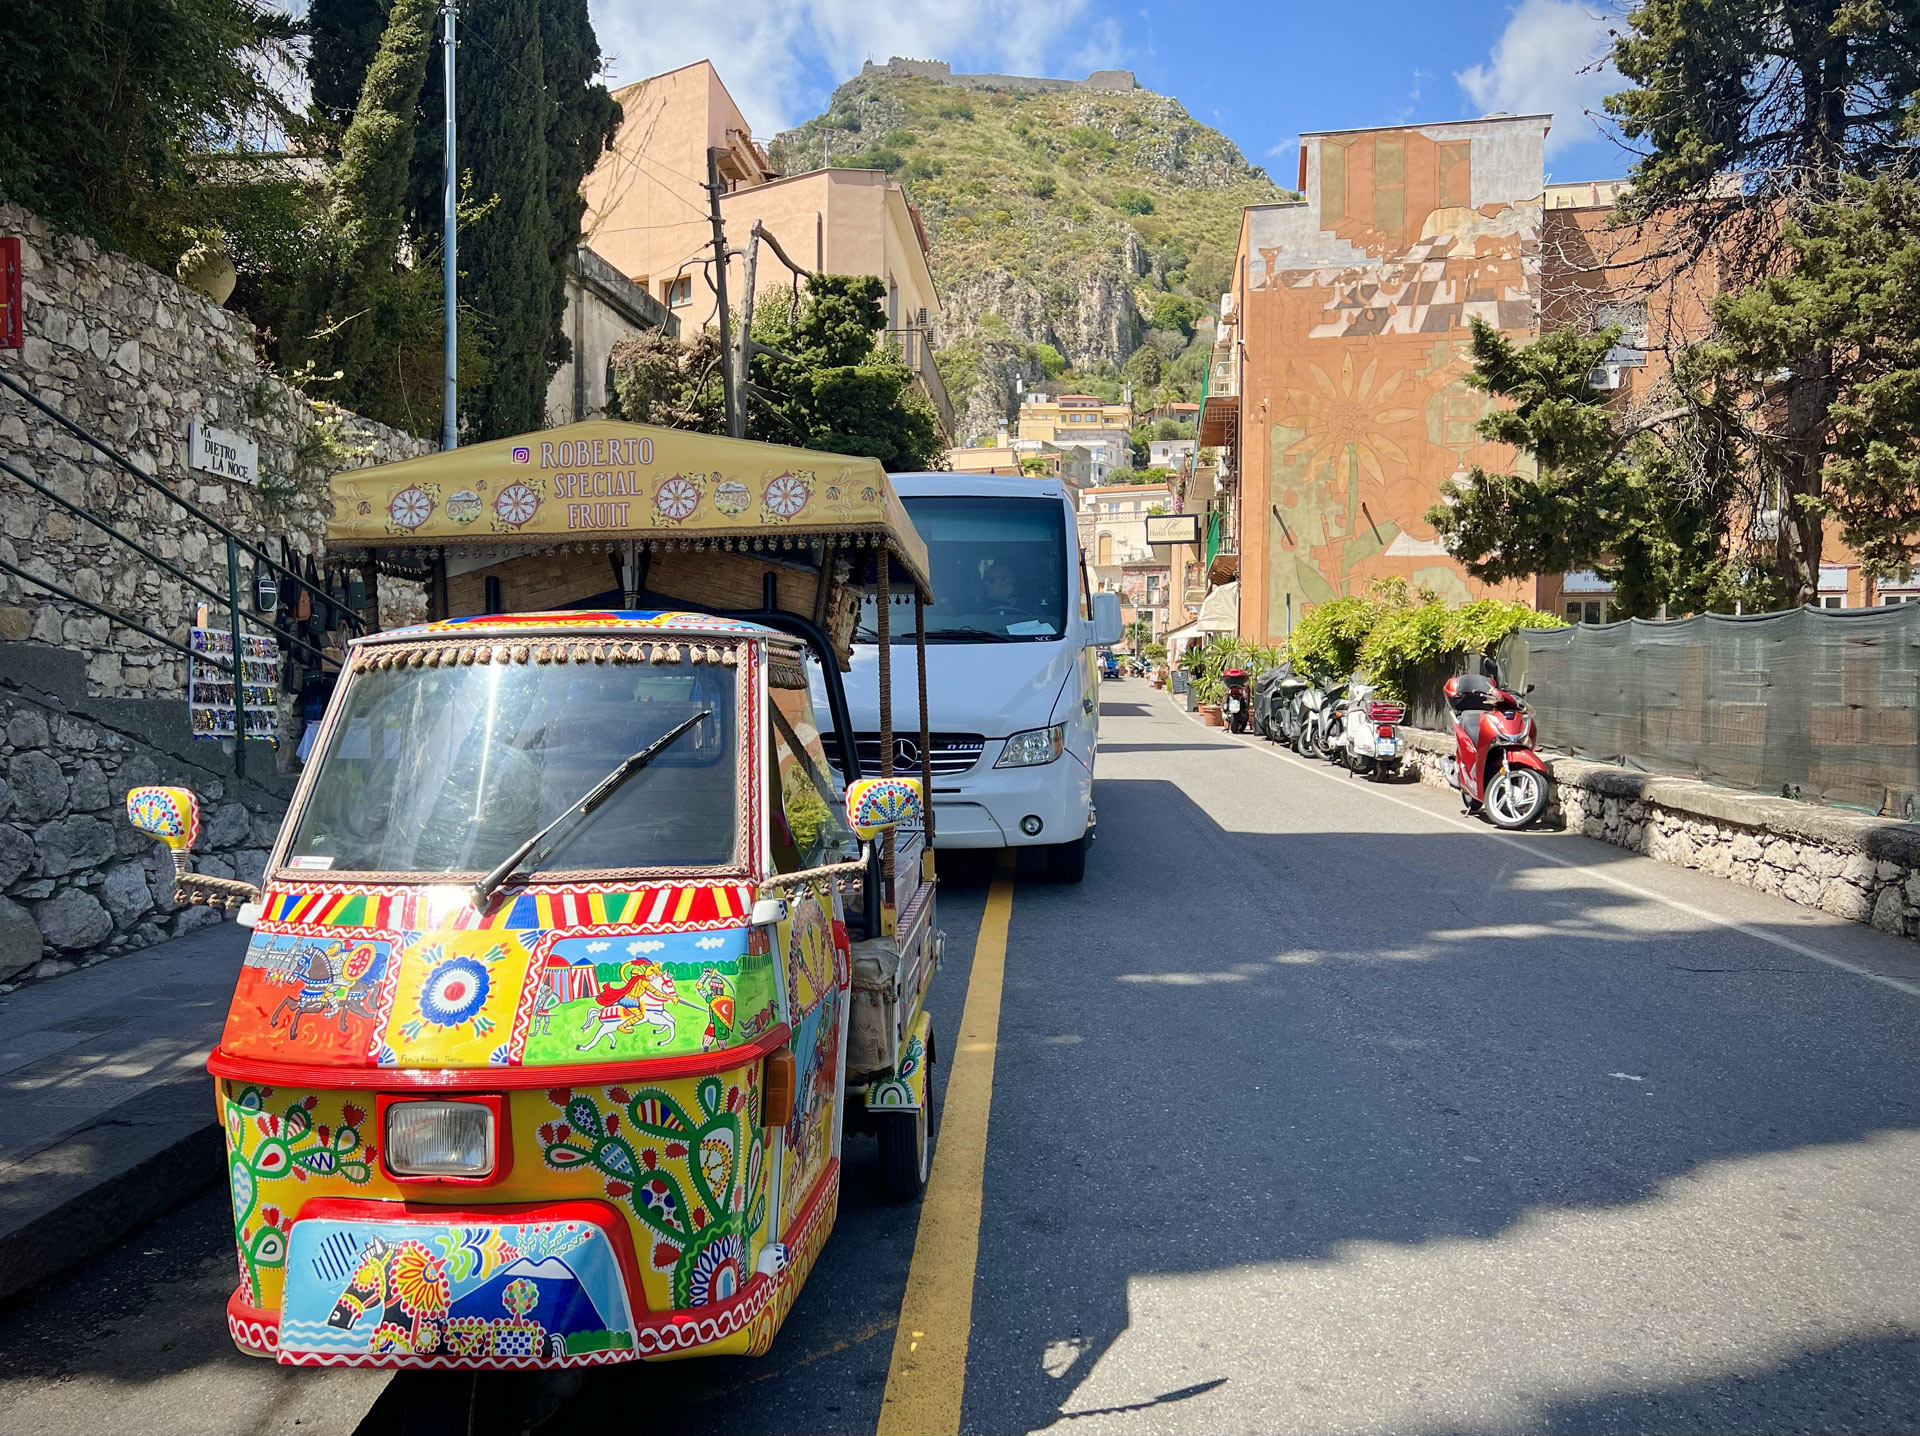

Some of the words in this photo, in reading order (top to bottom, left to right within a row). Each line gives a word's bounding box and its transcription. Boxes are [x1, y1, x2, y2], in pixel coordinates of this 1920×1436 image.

[200, 424, 211, 439] VIA
[205, 439, 236, 461] DIETRO
[540, 437, 654, 469] ROBERTO
[212, 456, 223, 472] LA
[228, 461, 249, 479] NOCE
[554, 471, 643, 498] SPECIAL
[568, 502, 630, 528] FRUIT
[1149, 529, 1166, 537] Hotel
